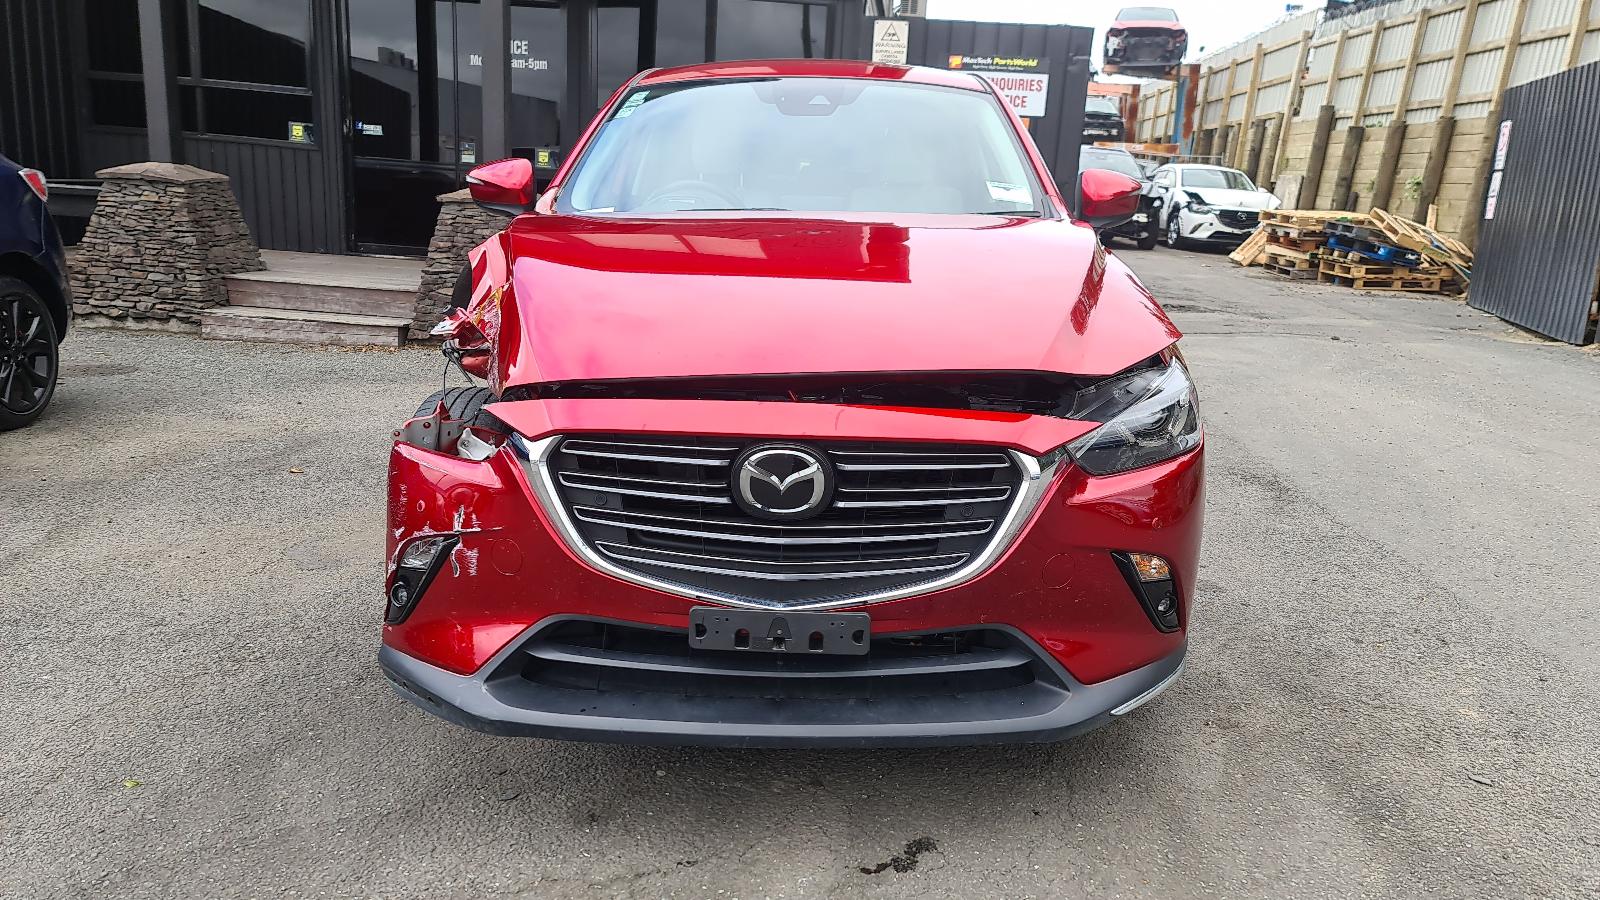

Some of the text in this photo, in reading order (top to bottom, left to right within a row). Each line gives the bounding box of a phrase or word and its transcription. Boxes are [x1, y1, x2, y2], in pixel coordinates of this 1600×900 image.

[510, 40, 529, 55] ICE
[510, 58, 548, 70] am-5pm
[988, 77, 1043, 92] NQUIRIES
[1005, 95, 1028, 108] ICE
